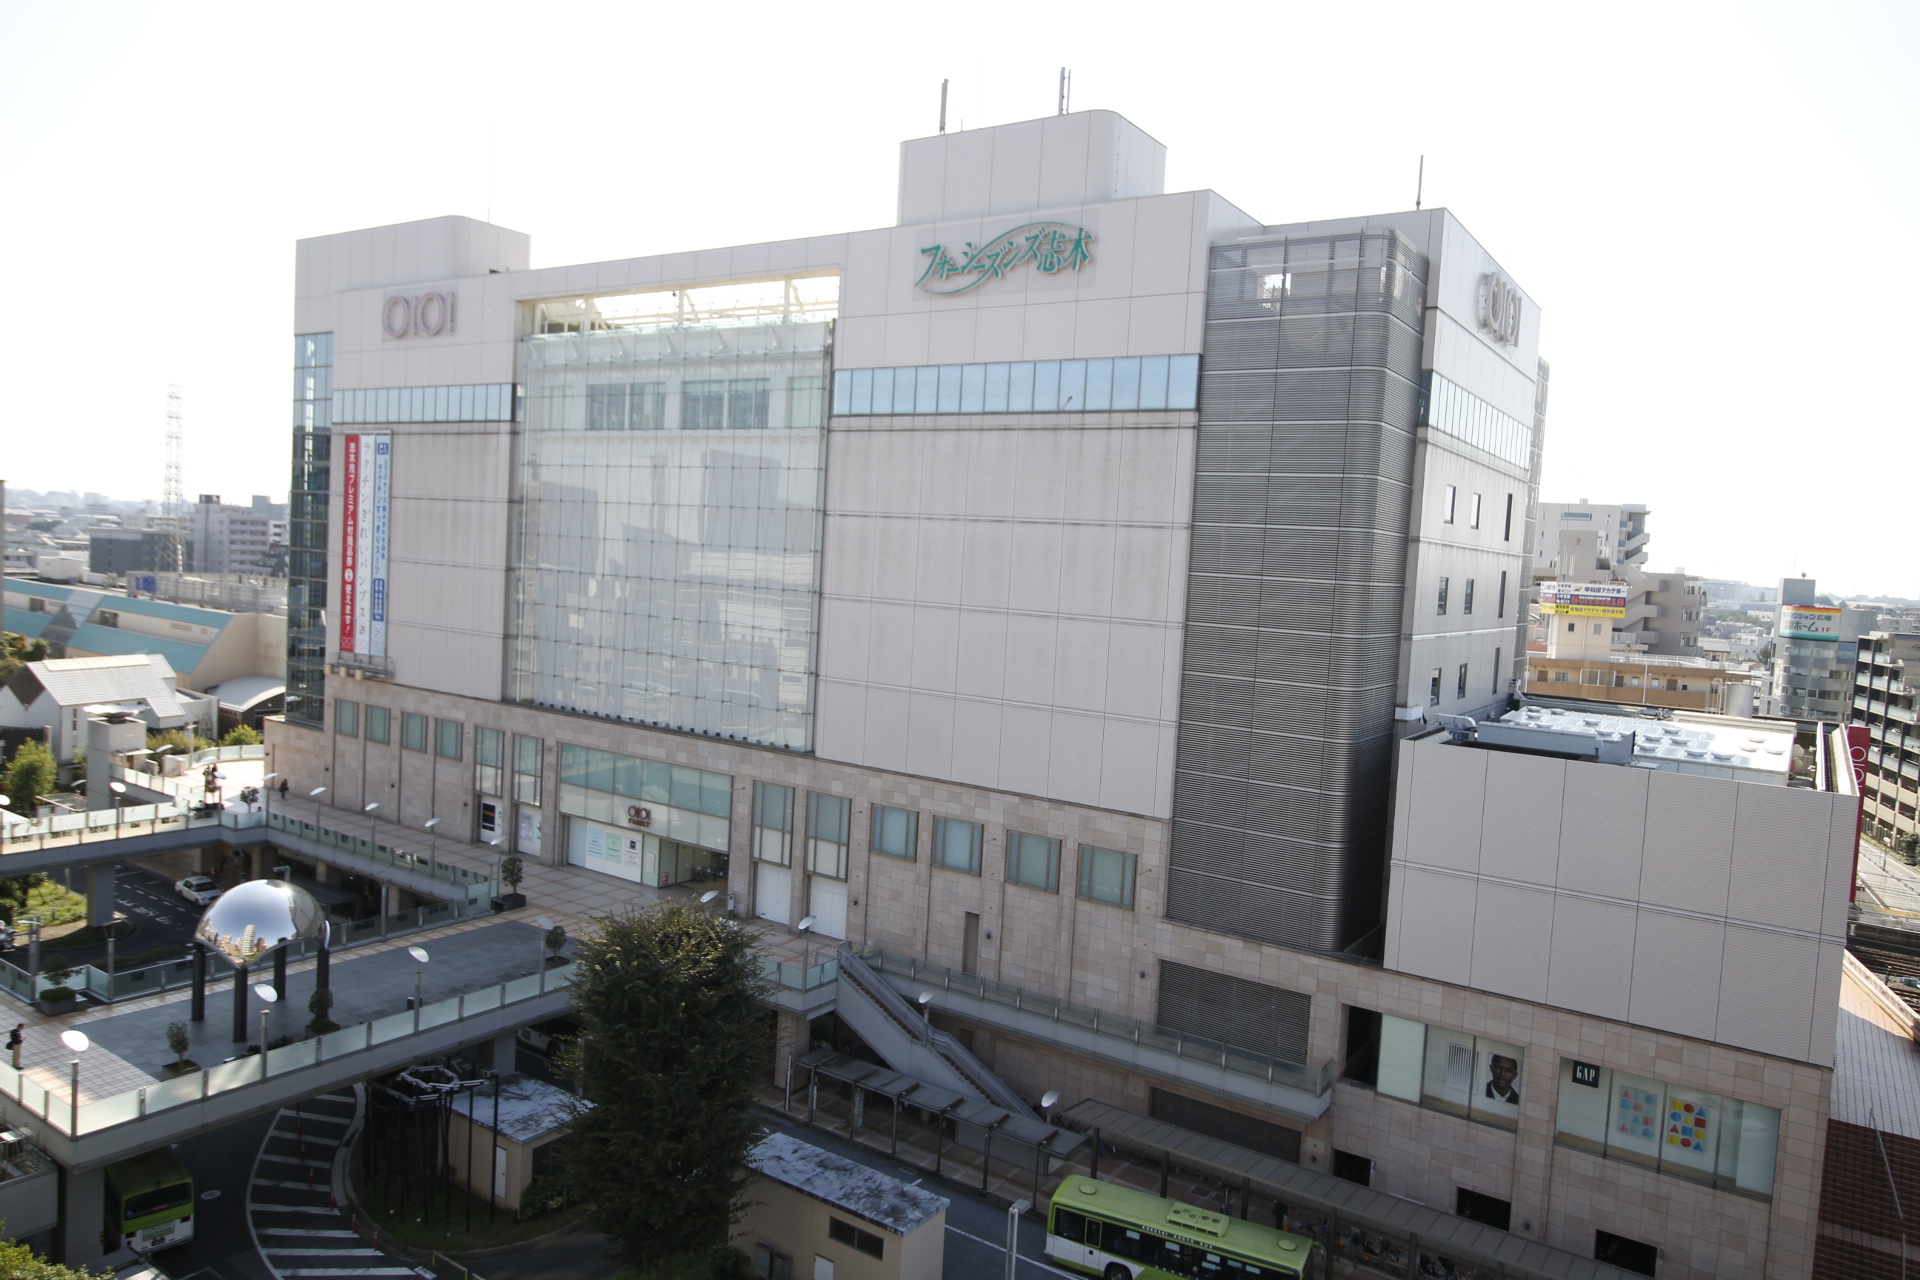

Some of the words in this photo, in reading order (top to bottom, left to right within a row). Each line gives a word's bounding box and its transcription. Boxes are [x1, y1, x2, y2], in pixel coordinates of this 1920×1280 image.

[915, 227, 1094, 287] フォーシーズンズ志木
[382, 292, 456, 338] OIOI
[627, 805, 651, 821] OIOI
[628, 817, 651, 828] FAMILY
[1576, 1065, 1596, 1082] GAP
[1141, 1225, 1168, 1236] KOKUSAI
[1173, 1234, 1194, 1244] KOGYO
